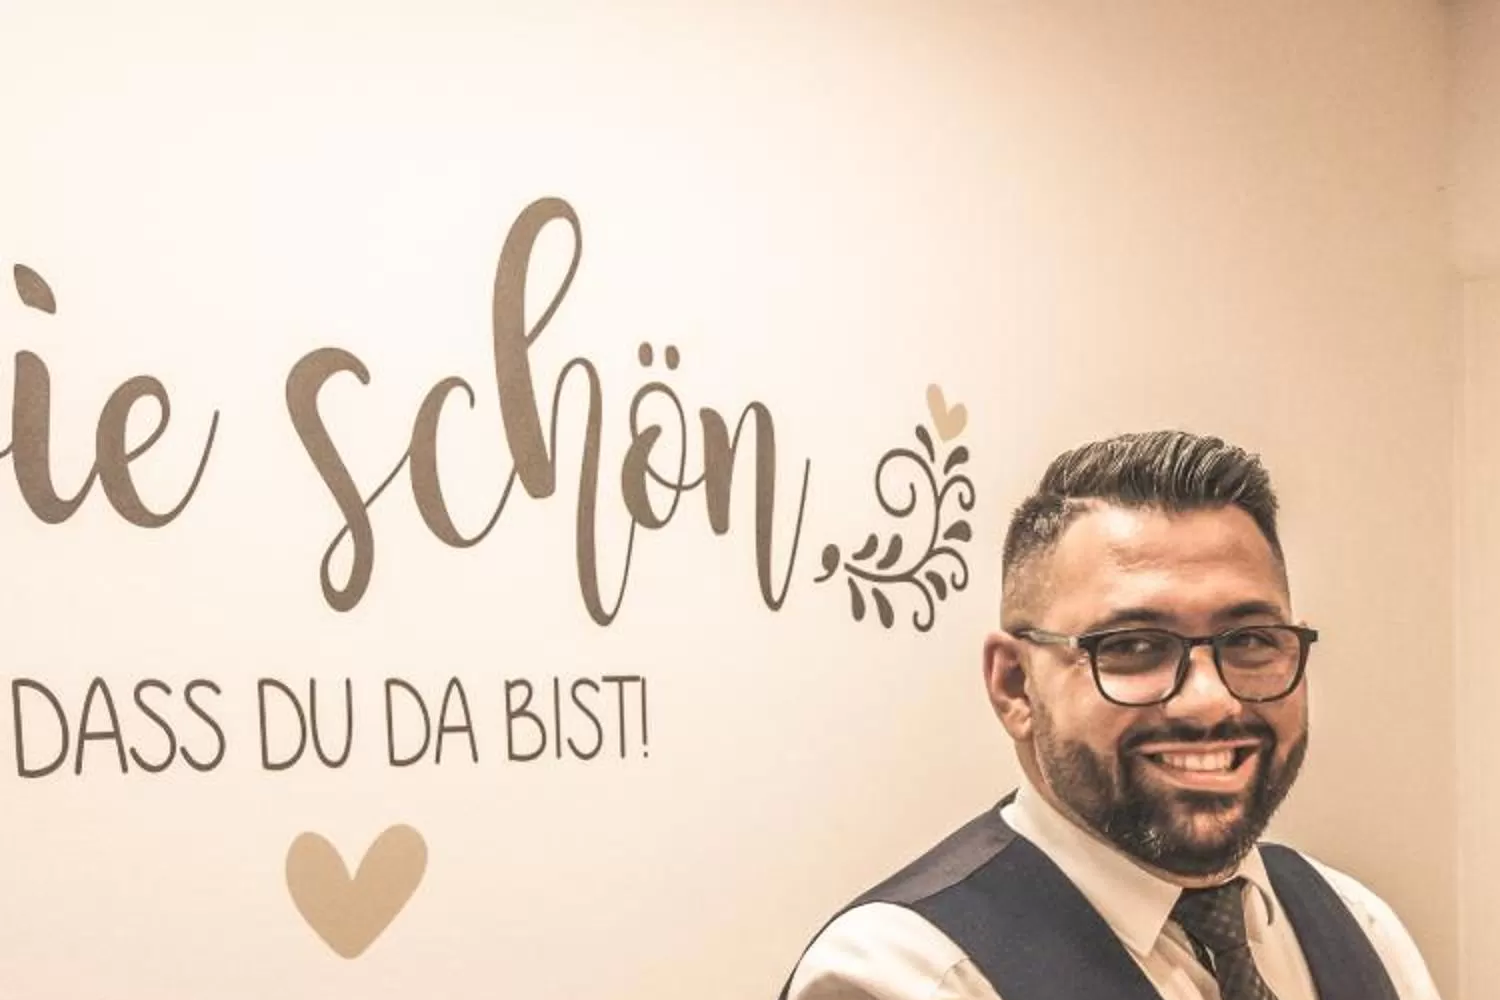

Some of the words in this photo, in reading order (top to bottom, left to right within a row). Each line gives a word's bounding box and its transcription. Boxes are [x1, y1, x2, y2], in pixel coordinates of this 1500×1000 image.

[0, 263, 220, 529] ie
[11, 676, 226, 779] DASS
[257, 677, 353, 771] DU
[384, 676, 479, 767] DA
[504, 675, 650, 763] BIST!
